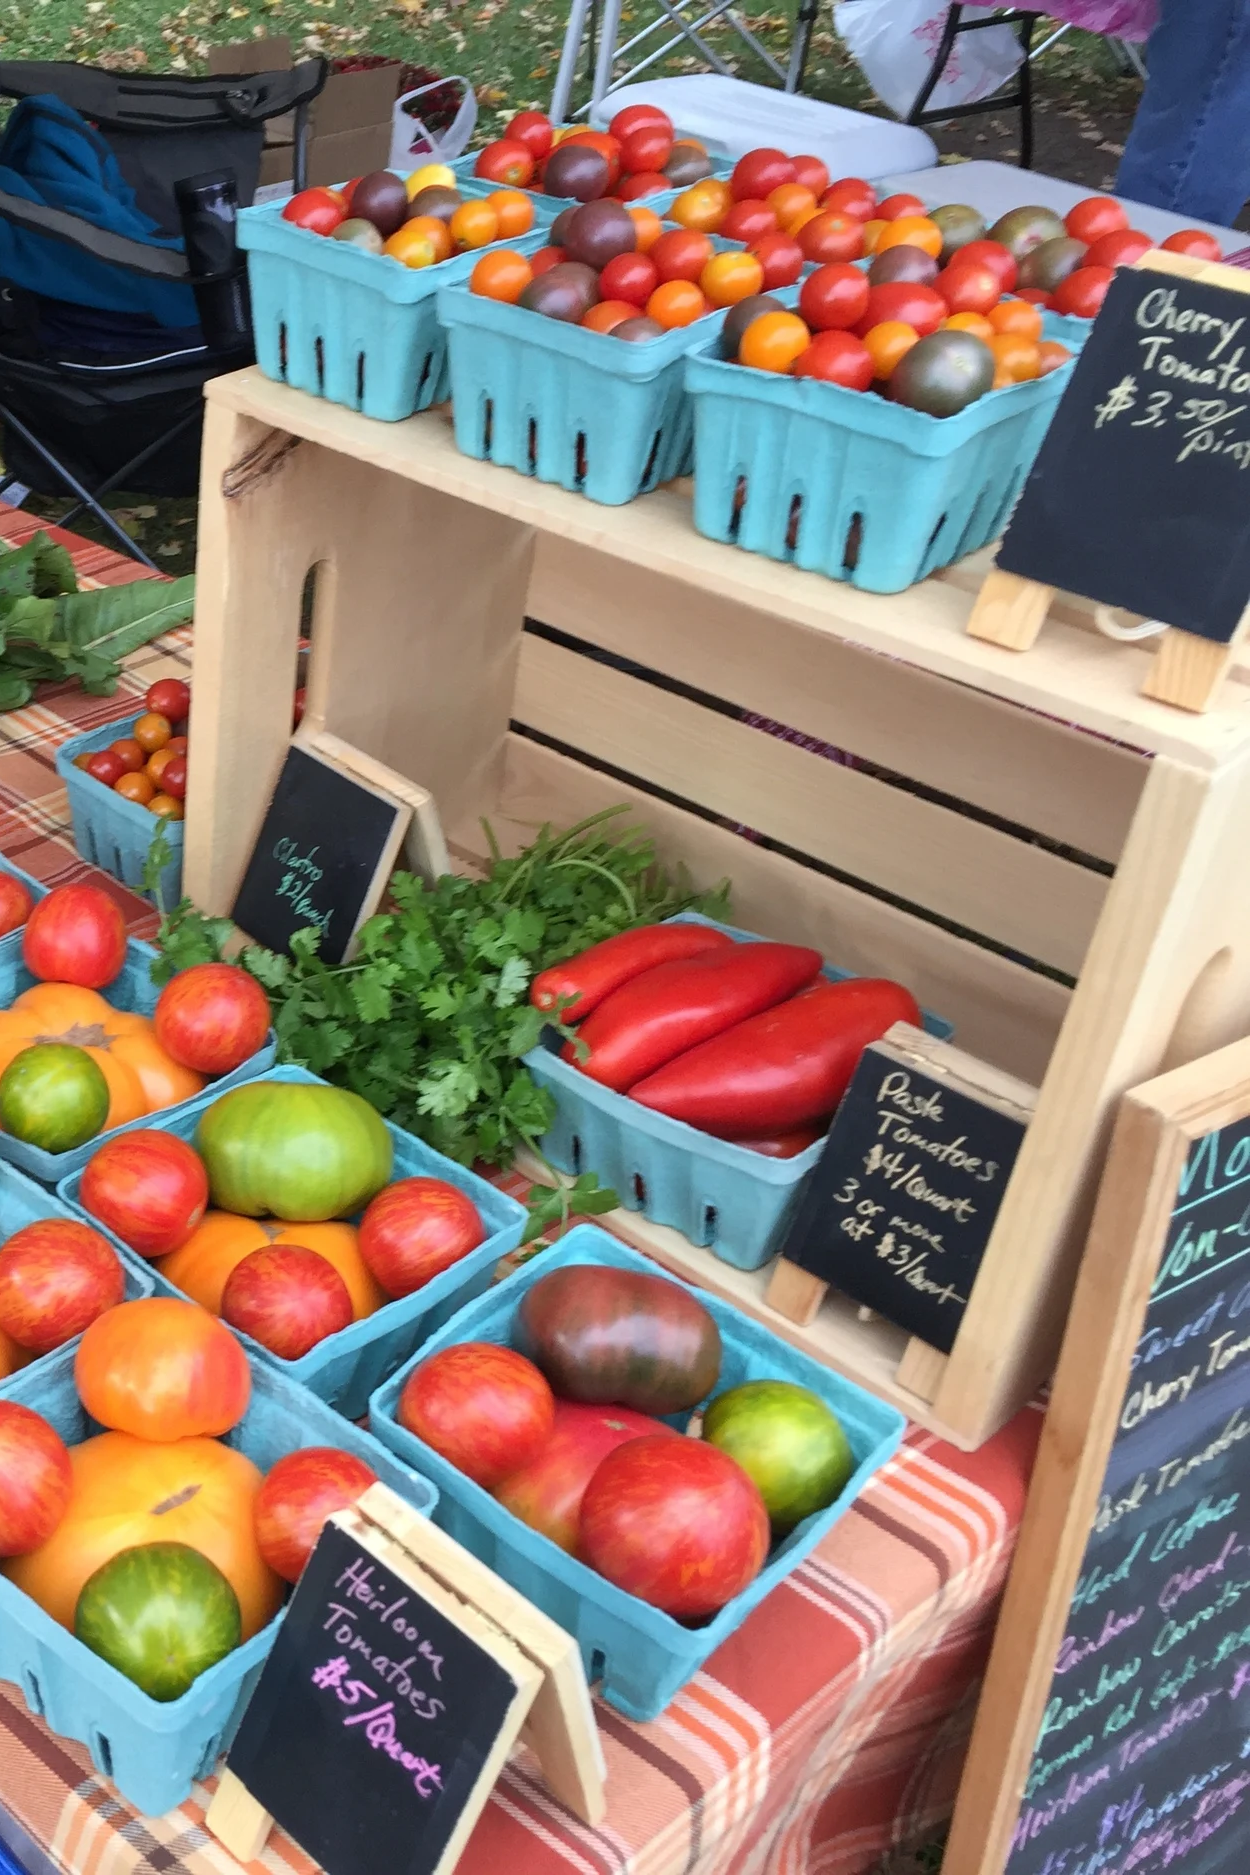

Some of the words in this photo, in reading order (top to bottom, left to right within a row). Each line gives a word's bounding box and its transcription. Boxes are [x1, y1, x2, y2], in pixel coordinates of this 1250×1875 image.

[1135, 288, 1247, 362] Cherry
[876, 1072, 944, 1122] Paste
[877, 1110, 999, 1182] Tomatoes
[833, 1177, 861, 1203] 3
[856, 1199, 886, 1218] or
[888, 1215, 946, 1253] more
[840, 1217, 875, 1241] at
[334, 1558, 443, 1681] Heirloom
[323, 1602, 446, 1720] Tomatoes
[1033, 1657, 1142, 1753] Rainbow
